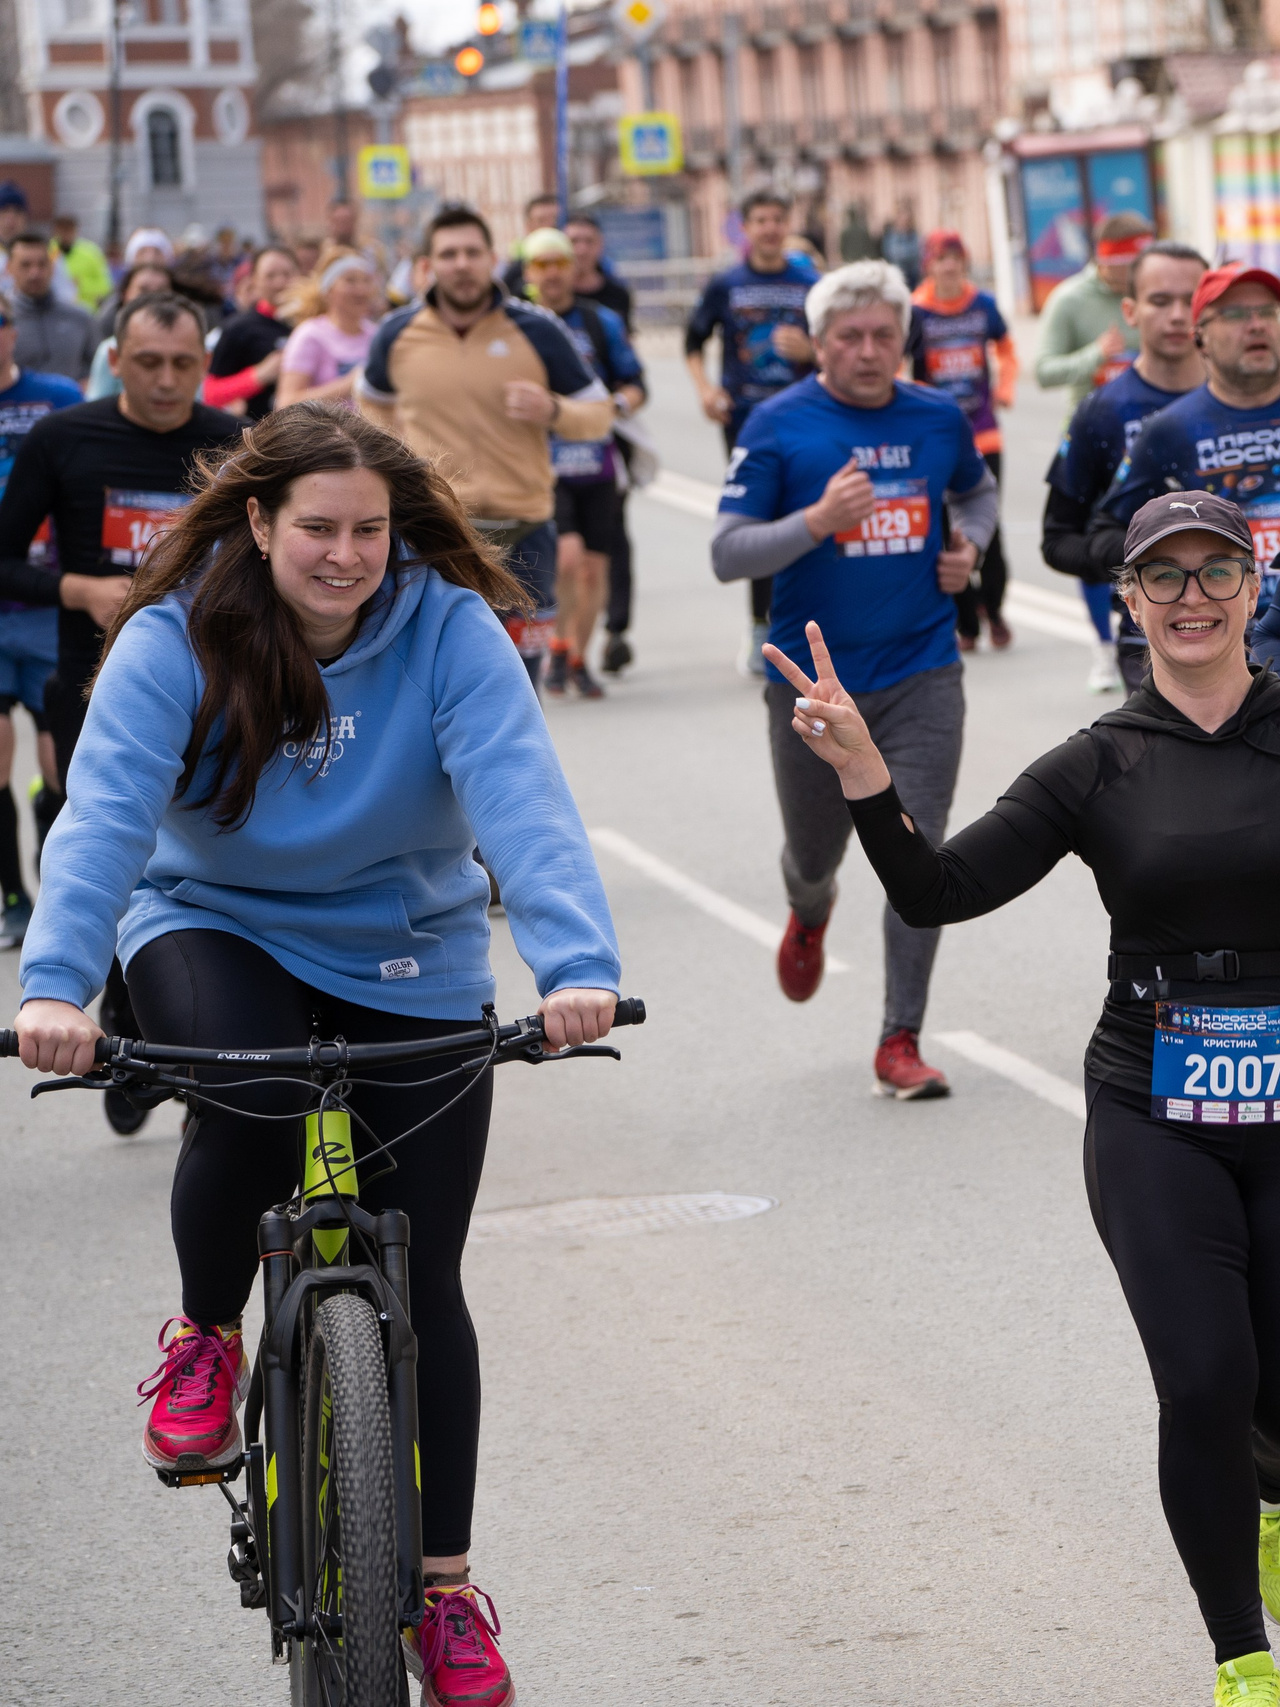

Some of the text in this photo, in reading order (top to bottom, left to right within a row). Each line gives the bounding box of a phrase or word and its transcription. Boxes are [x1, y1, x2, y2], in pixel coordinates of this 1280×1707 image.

[1196, 438, 1216, 453] Я
[385, 960, 414, 973] VOLGA
[1212, 1014, 1267, 1023] ПРОСТО
[1201, 1021, 1267, 1031] КОСМОС
[1203, 1038, 1258, 1049] КРИСТИНА
